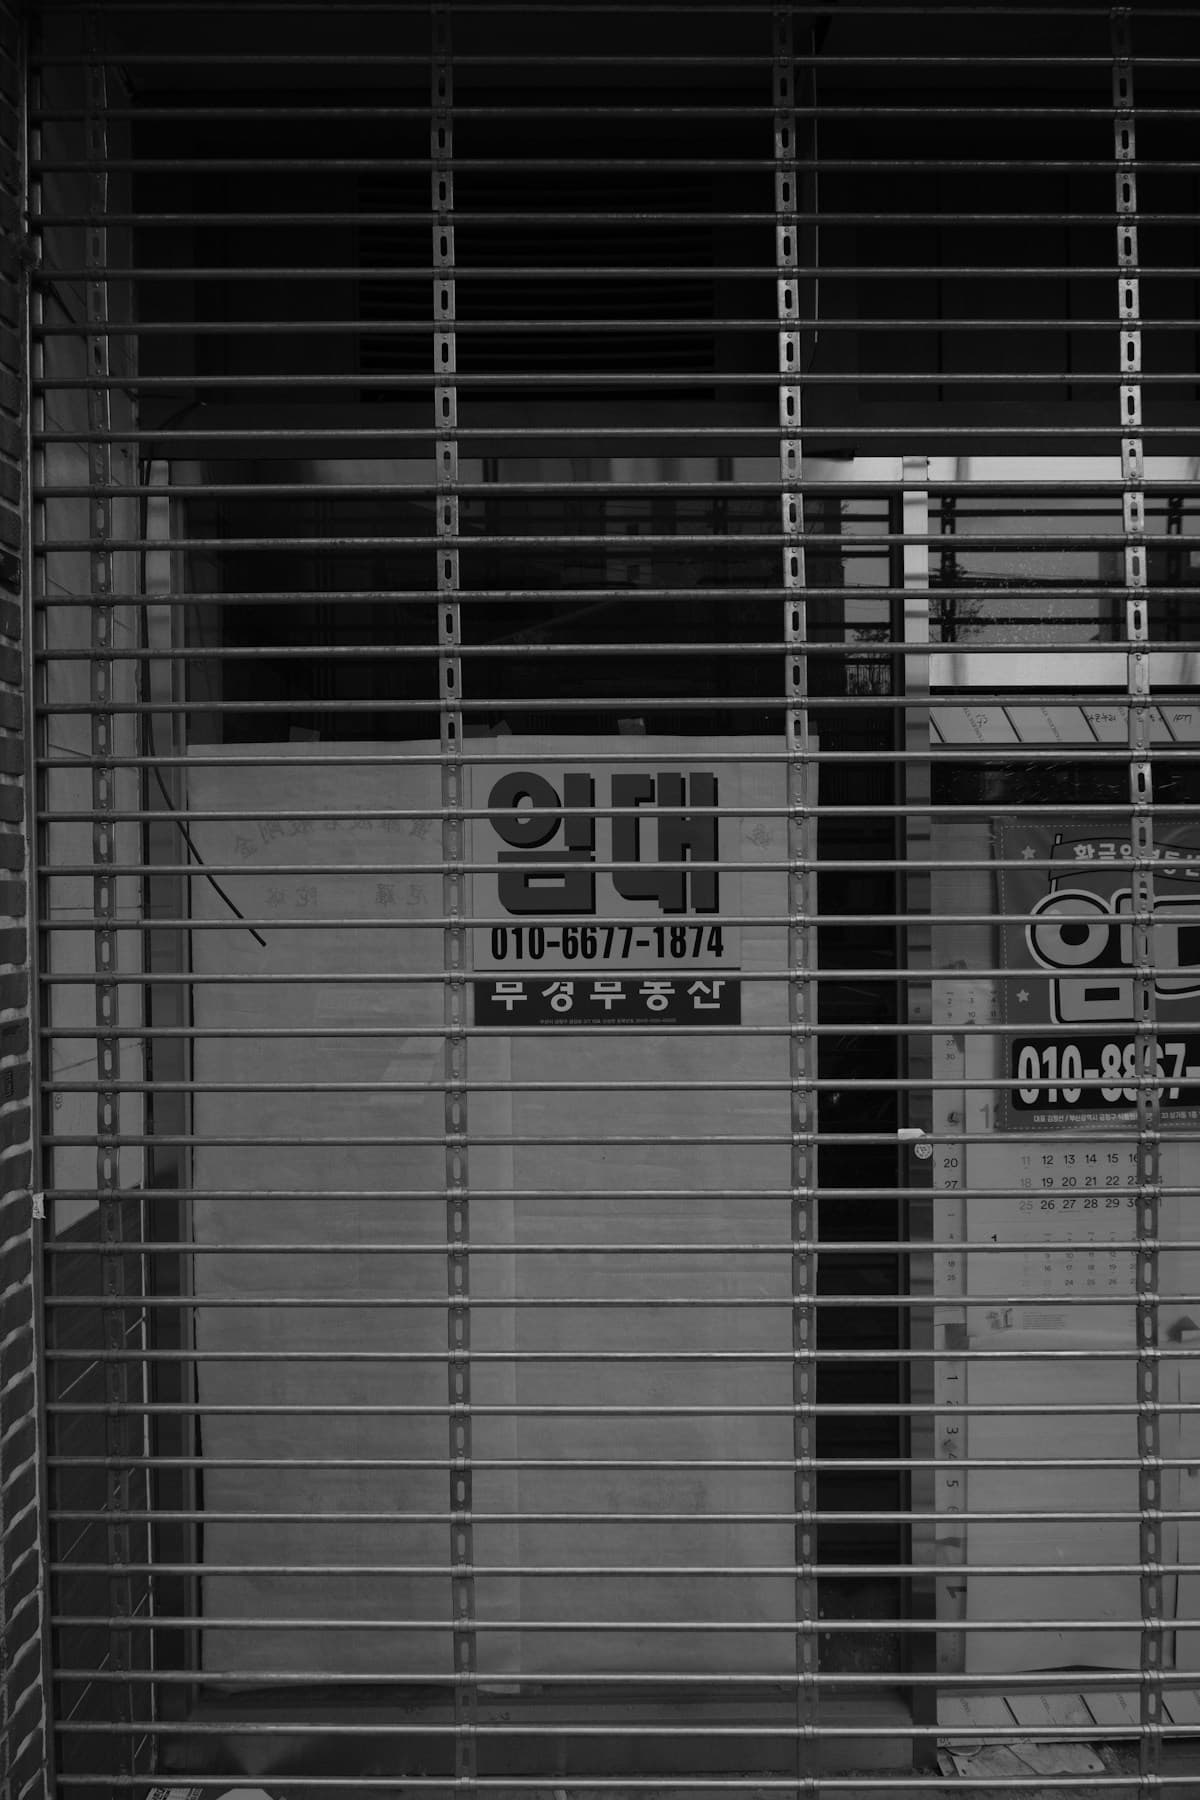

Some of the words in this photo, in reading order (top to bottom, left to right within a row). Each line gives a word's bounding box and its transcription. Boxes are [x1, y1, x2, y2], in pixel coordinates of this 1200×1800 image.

[487, 771, 719, 915] 임대
[491, 925, 724, 960] 010-6677-1874
[943, 1158, 958, 1168] 20
[1042, 1154, 1054, 1165] 12
[1064, 1153, 1076, 1164] 13
[1085, 1153, 1097, 1164] 14
[1107, 1152, 1119, 1163] 15
[1042, 1177, 1054, 1187] 19
[1062, 1176, 1077, 1187] 20
[1084, 1176, 1097, 1186] 21
[1105, 1175, 1120, 1186] 22
[1040, 1199, 1055, 1210] 26
[1062, 1199, 1077, 1209] 27
[1083, 1199, 1098, 1209] 28
[1105, 1199, 1120, 1208] 29
